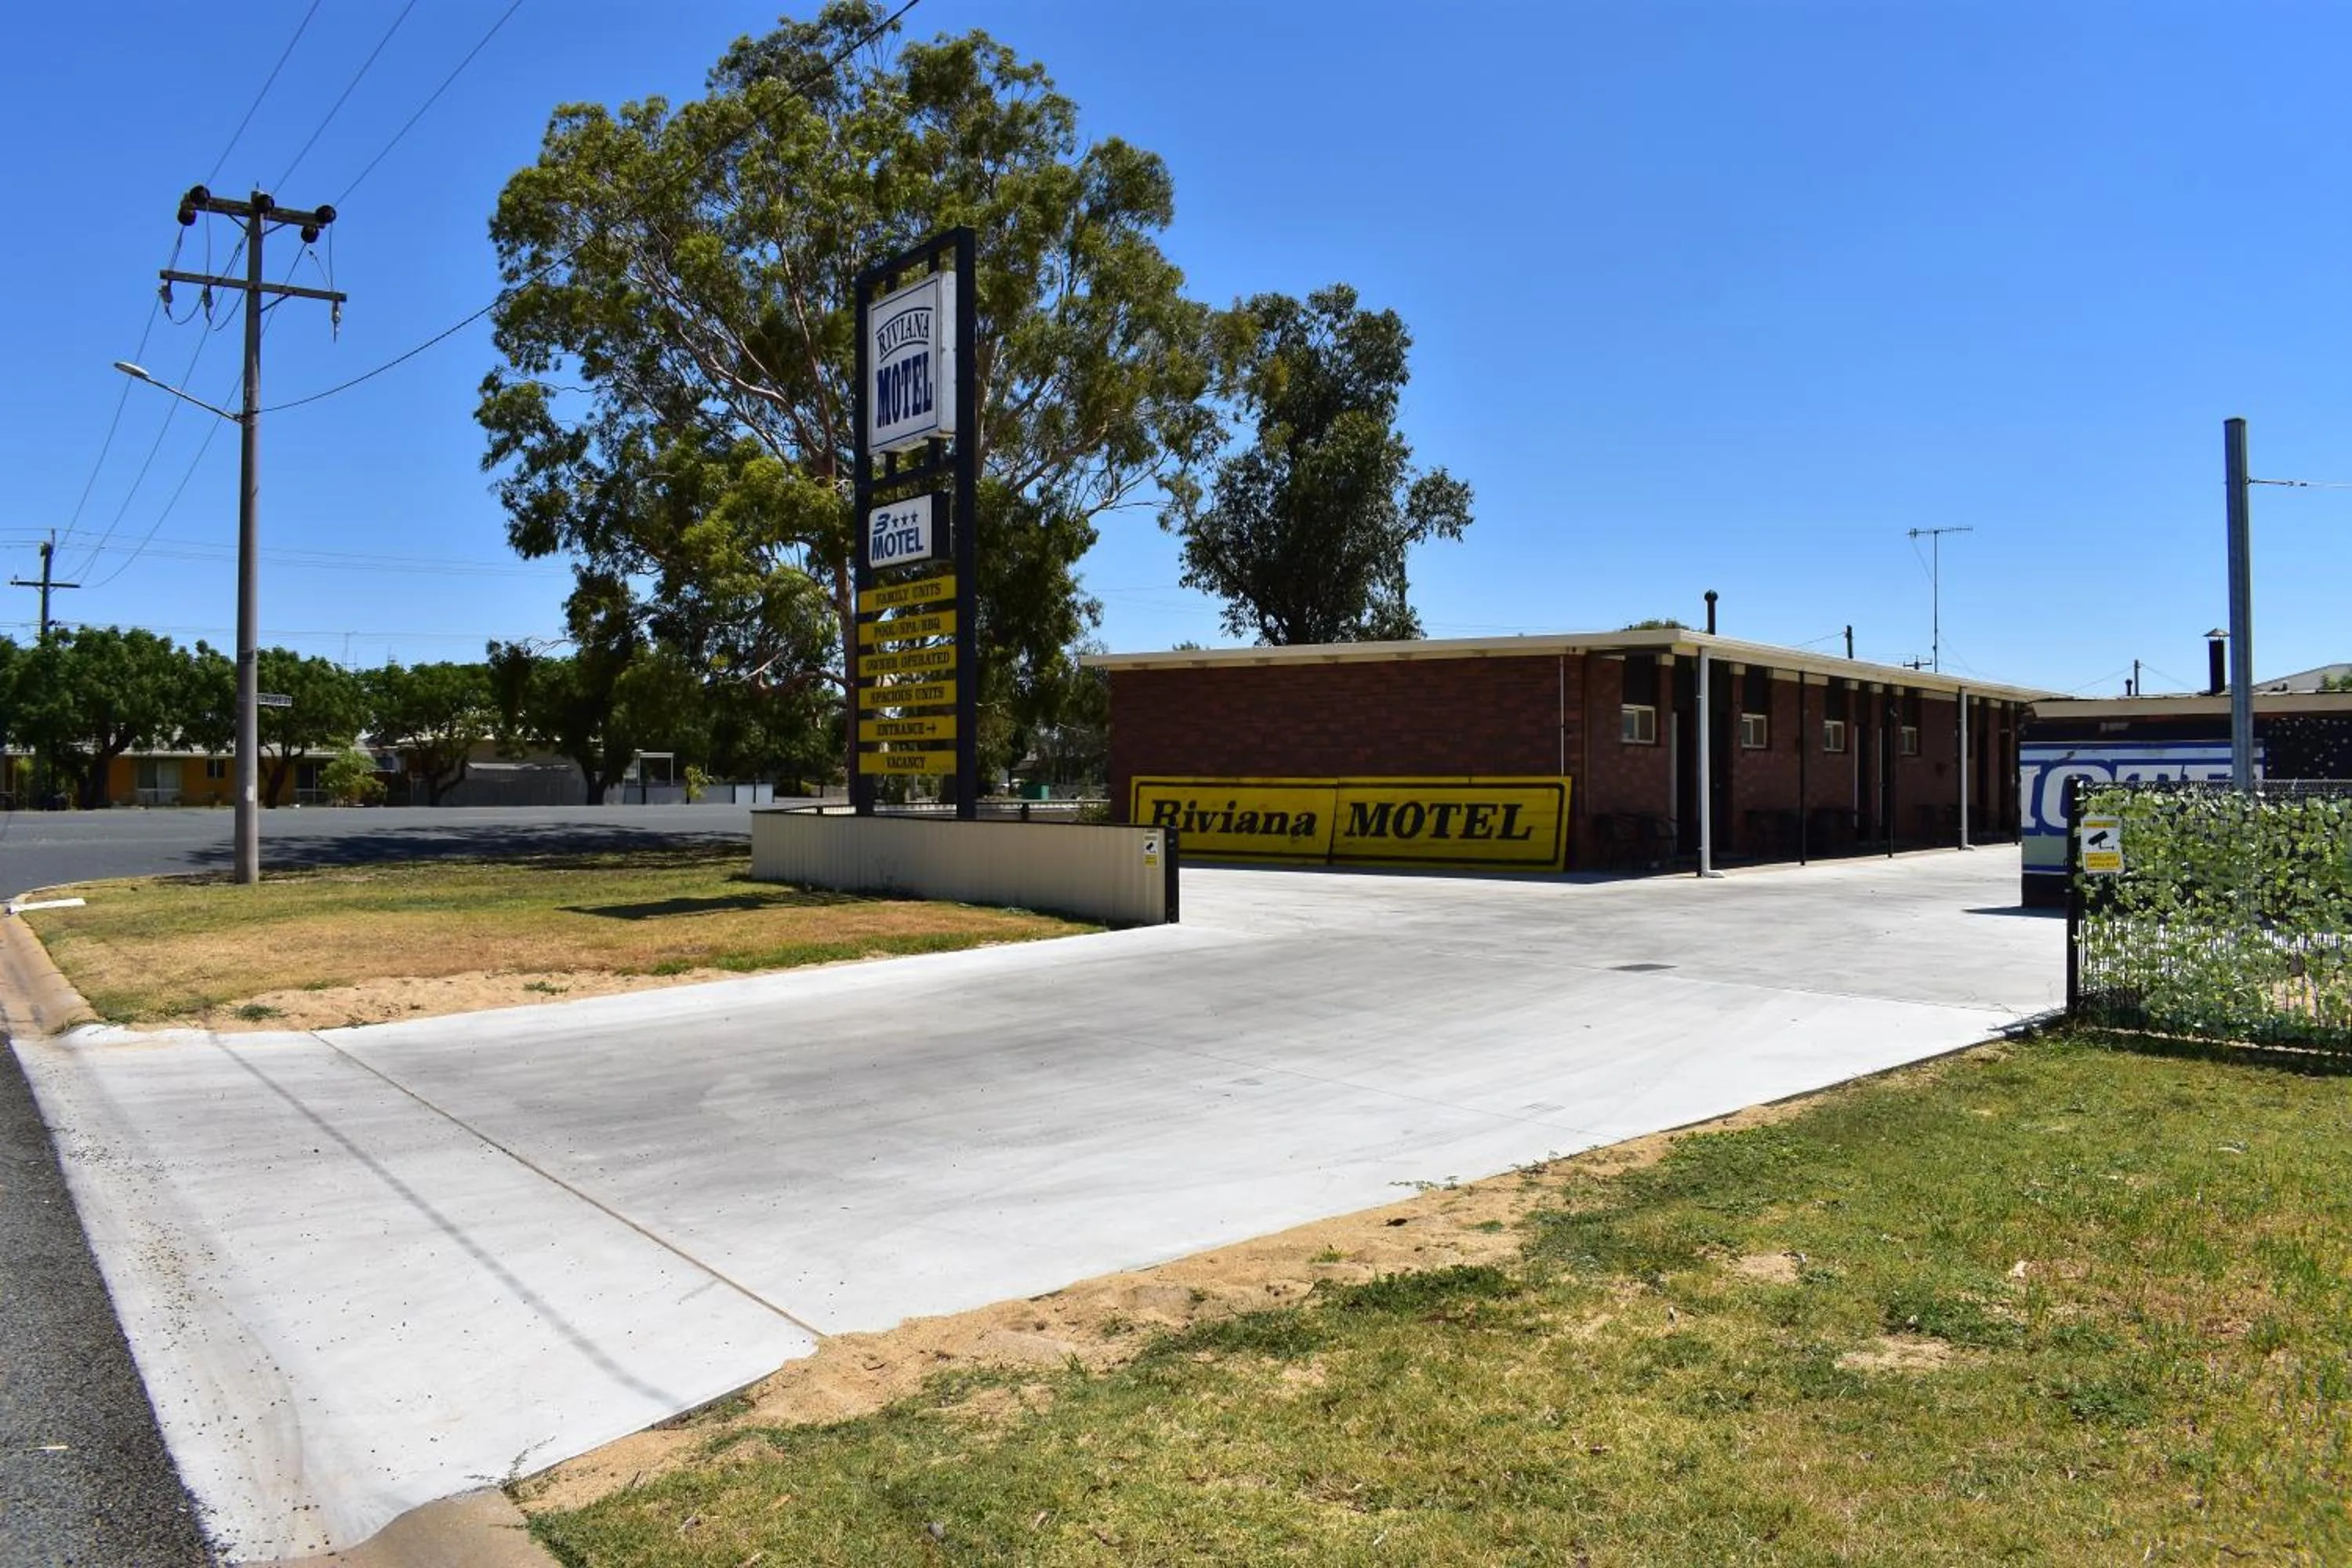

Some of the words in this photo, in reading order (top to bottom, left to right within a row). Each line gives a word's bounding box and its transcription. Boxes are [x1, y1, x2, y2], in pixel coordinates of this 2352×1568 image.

[877, 314, 929, 357] RIVIANA
[877, 351, 932, 428] MOTEL
[872, 526, 924, 561] MOTEL
[876, 589, 908, 604] FAMILY
[913, 583, 942, 598] UNITS
[866, 658, 897, 671] OWNER
[901, 652, 950, 668] OPERATED
[870, 688, 913, 703] SPACIOUS
[915, 686, 945, 700] UNITS
[877, 722, 924, 736] ENTRANCE
[886, 756, 926, 769] VACANCY
[1152, 800, 1317, 837] Riviana
[1344, 802, 1533, 840] MOTEL
